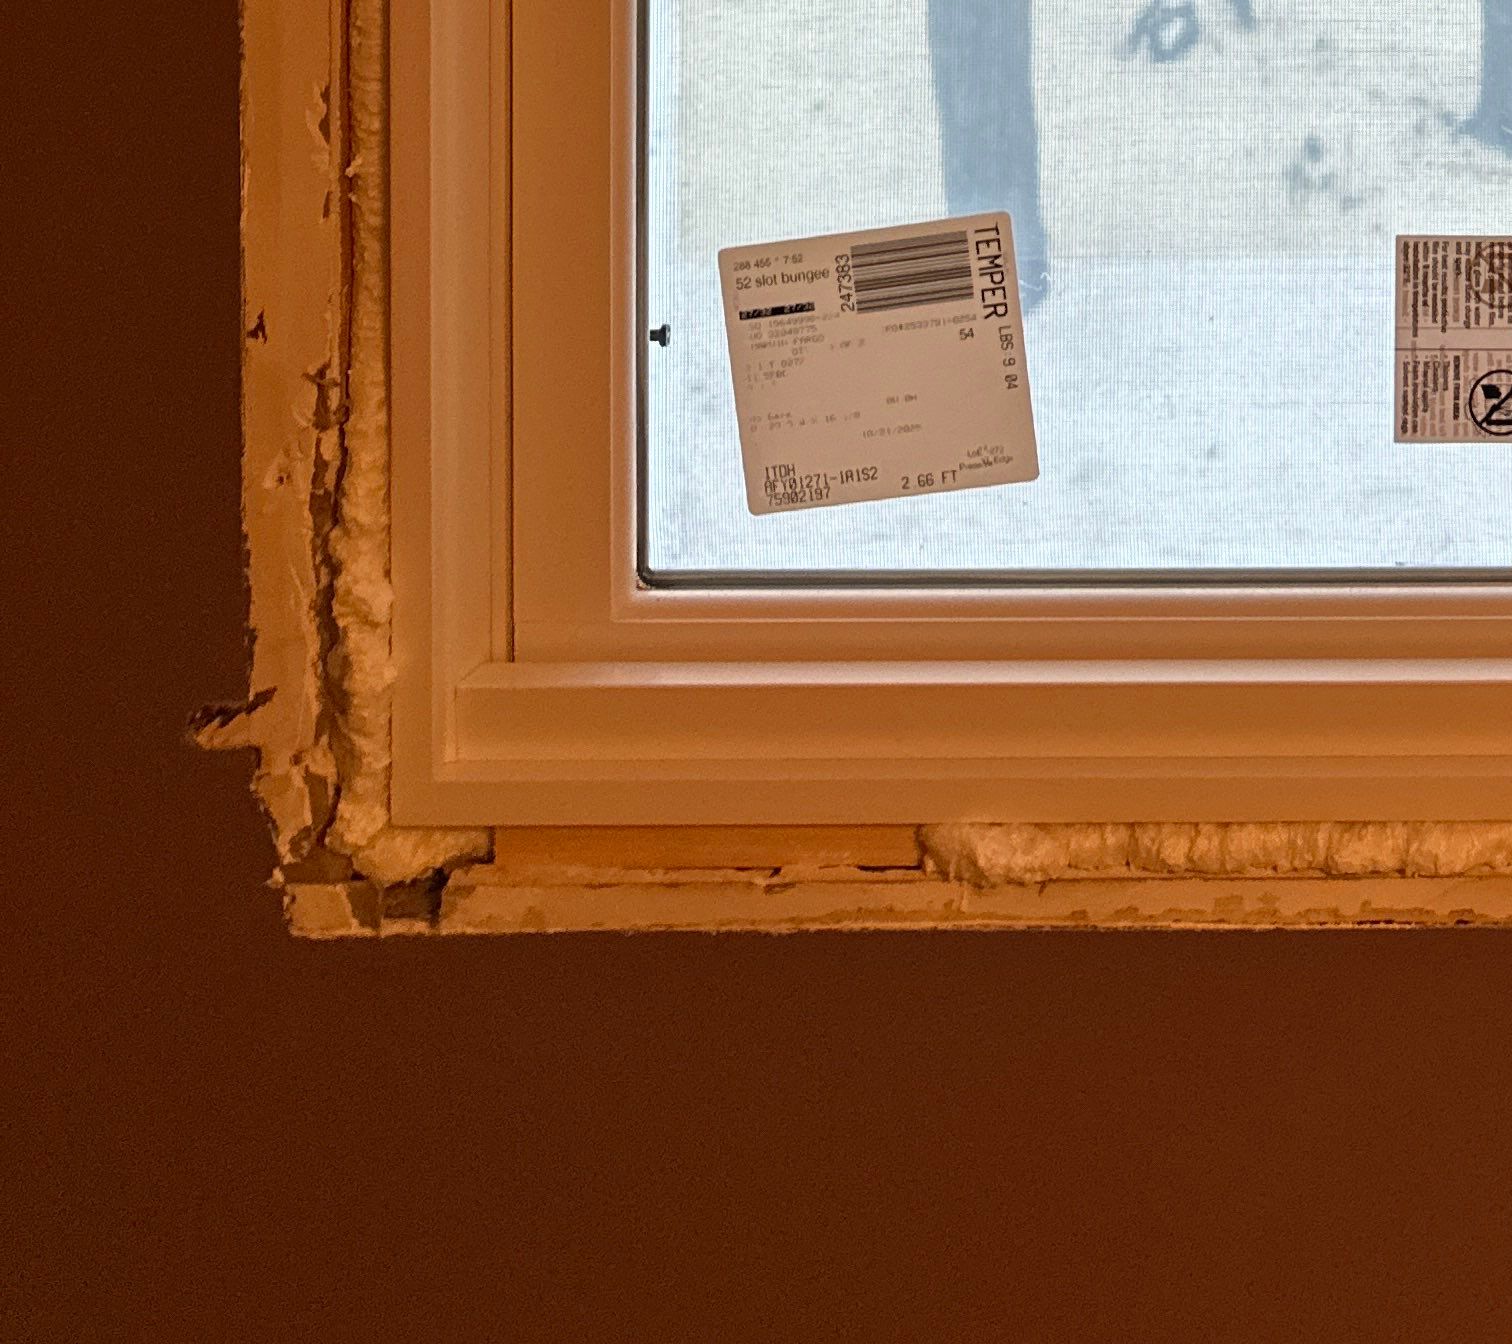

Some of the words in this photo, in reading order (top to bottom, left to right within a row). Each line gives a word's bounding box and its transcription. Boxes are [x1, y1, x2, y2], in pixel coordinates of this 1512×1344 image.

[736, 276, 752, 291] 52
[755, 274, 778, 288] slot
[781, 268, 830, 284] bungee
[974, 221, 1009, 320] TEMPER
[835, 253, 855, 313] 247383
[959, 327, 975, 341] 54
[942, 470, 958, 484] FT
